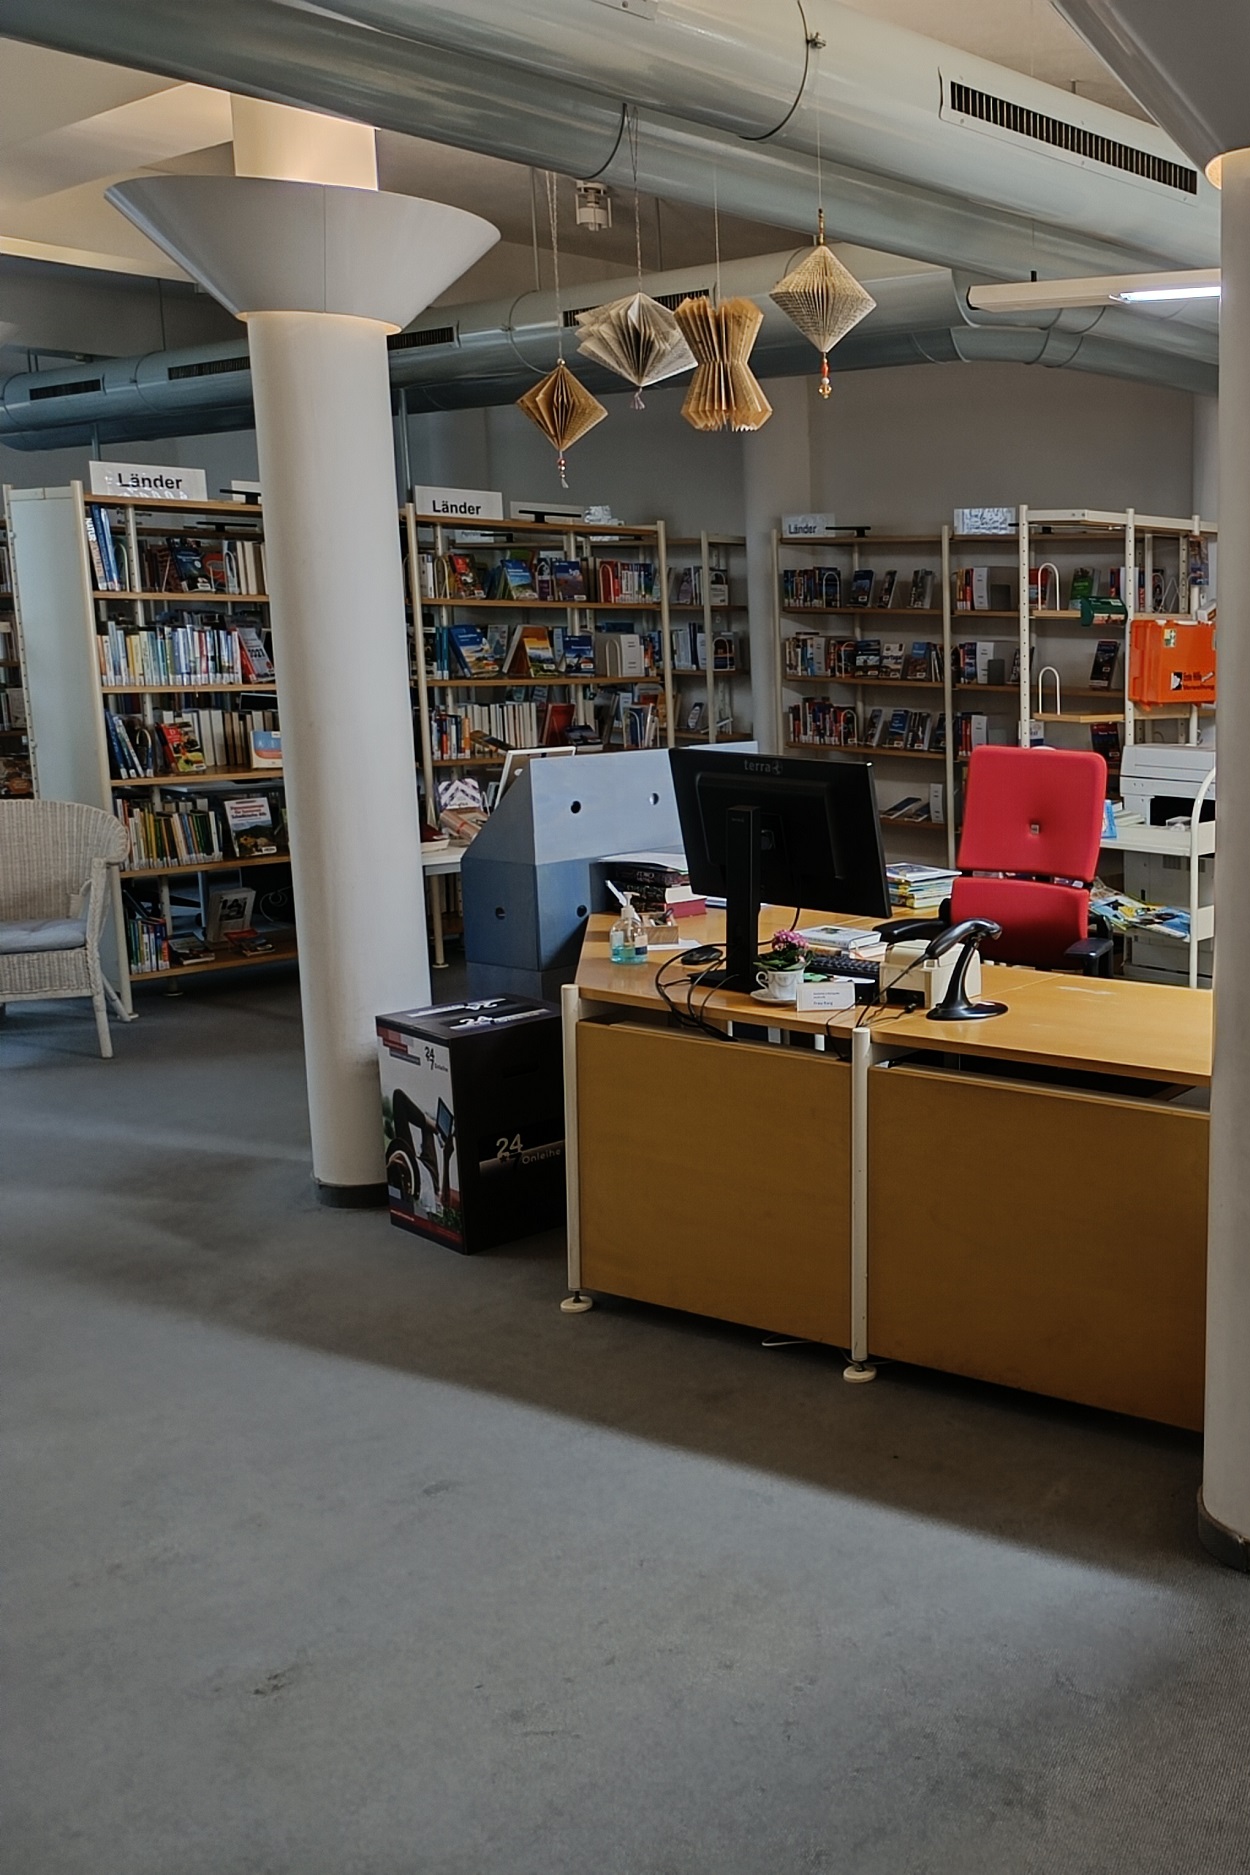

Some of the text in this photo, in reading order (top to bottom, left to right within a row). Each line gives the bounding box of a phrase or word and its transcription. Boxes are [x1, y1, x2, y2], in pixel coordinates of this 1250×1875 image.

[118, 473, 182, 489] Länder
[432, 500, 482, 515] Länder
[788, 524, 817, 534] Länder
[744, 760, 771, 772] terra
[425, 1046, 435, 1058] 24
[496, 1133, 523, 1160] 24
[522, 1148, 561, 1164] Onleihe
